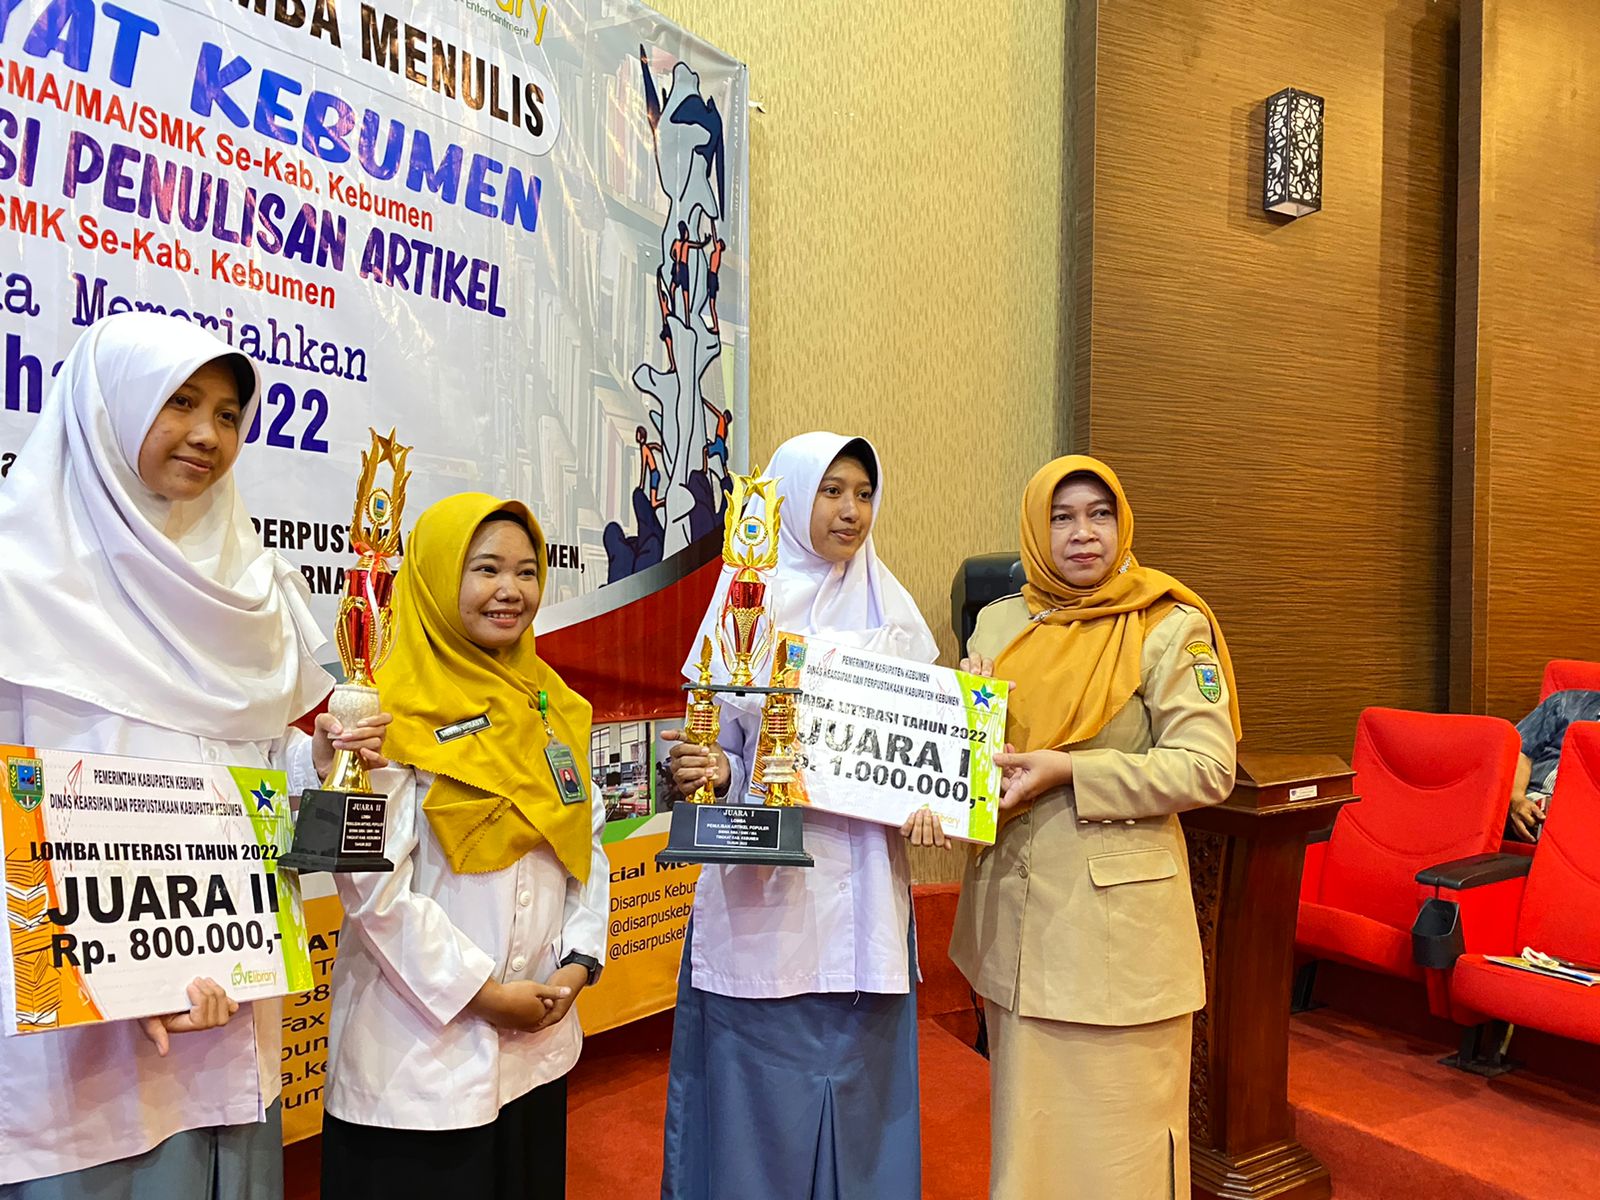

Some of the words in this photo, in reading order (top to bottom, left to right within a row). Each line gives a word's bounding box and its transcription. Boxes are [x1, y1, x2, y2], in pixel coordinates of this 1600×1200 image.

[361, 3, 545, 137] MENULIS
[0, 57, 206, 158] MA/MA/SMK
[215, 133, 320, 193] Se-Kab.
[328, 171, 433, 232] Kebumen
[190, 42, 542, 232] KEBUMEN
[62, 130, 347, 272] PENULISAN
[360, 226, 507, 318] ARTIKEL
[0, 193, 66, 243] MK
[77, 214, 200, 275] Se-Kab.
[211, 249, 336, 310] Kebumen
[797, 716, 944, 774] JUARA
[958, 748, 972, 778] I
[902, 715, 948, 735] TAHUN
[950, 725, 987, 744] 2022
[50, 793, 72, 809] DINAS
[74, 795, 113, 812] KEARSIPAN
[115, 798, 128, 812] DAN
[129, 799, 179, 814] PERPUSTAKAAN
[180, 801, 214, 816] KABUPATEN
[215, 803, 243, 817] KEBUMEN
[94, 769, 137, 787] PEMERINTAH
[137, 773, 175, 789] KABUPATEN
[176, 776, 204, 791] KEBUMEN
[723, 809, 748, 817] JUARA
[30, 841, 100, 861] LOMBA
[105, 842, 182, 861] LITERASI
[185, 844, 238, 861] TAHUN
[241, 844, 279, 861] 2022
[47, 874, 237, 926] JUARA
[250, 873, 279, 914] II
[610, 889, 661, 913] Disarpus
[51, 932, 116, 974] Rp.
[130, 920, 282, 961] 800.000,-
